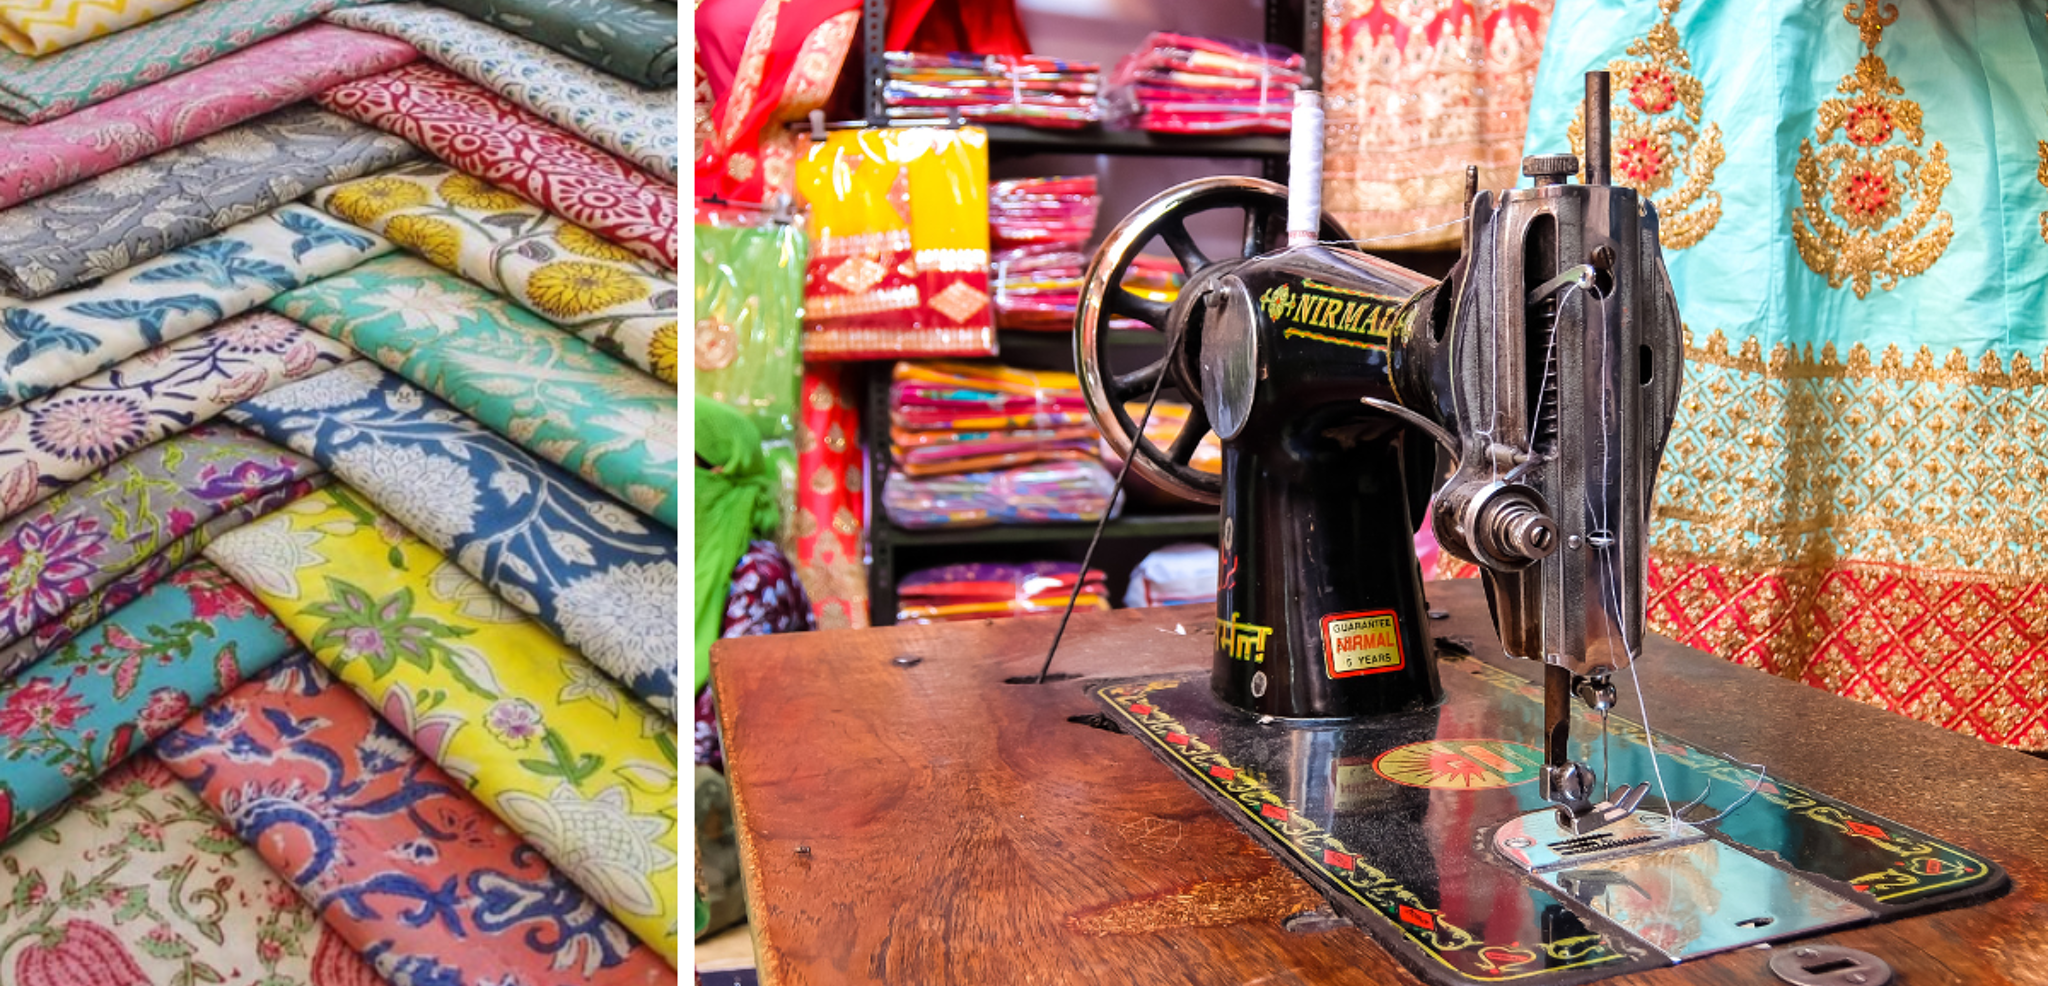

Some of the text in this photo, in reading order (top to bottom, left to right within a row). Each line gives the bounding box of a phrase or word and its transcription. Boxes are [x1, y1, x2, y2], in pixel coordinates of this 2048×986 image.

[1292, 292, 1395, 338] NIRMAL
[1333, 618, 1391, 633] GUARANTEE
[1336, 631, 1395, 654] NIRMAL
[1358, 653, 1392, 665] YEARS
